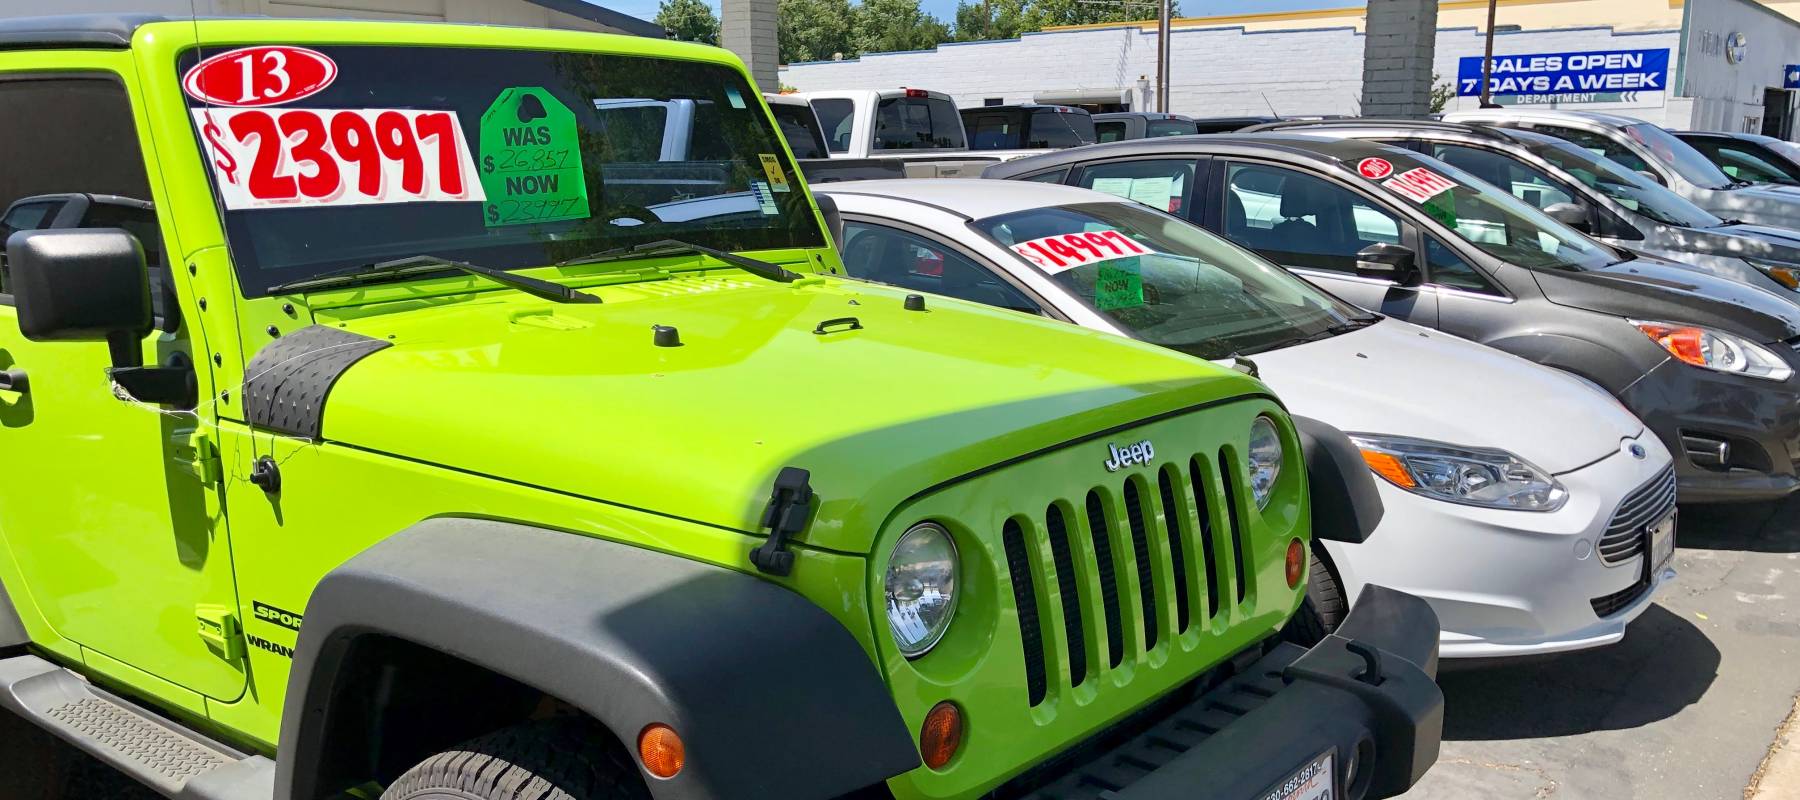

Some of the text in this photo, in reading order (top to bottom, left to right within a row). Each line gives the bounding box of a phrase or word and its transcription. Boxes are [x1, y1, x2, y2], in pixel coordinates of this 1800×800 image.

[1480, 53, 1644, 74] SALES OPEN
[234, 50, 291, 103] 13
[1461, 72, 1660, 93] 7 DAYS A WEEK
[1516, 93, 1597, 104] DEPARTMENT
[502, 126, 552, 147] WAS
[505, 174, 559, 196] NOW
[1017, 230, 1145, 268] $14997
[1104, 279, 1129, 293] NOW
[1104, 439, 1155, 472] Jeep
